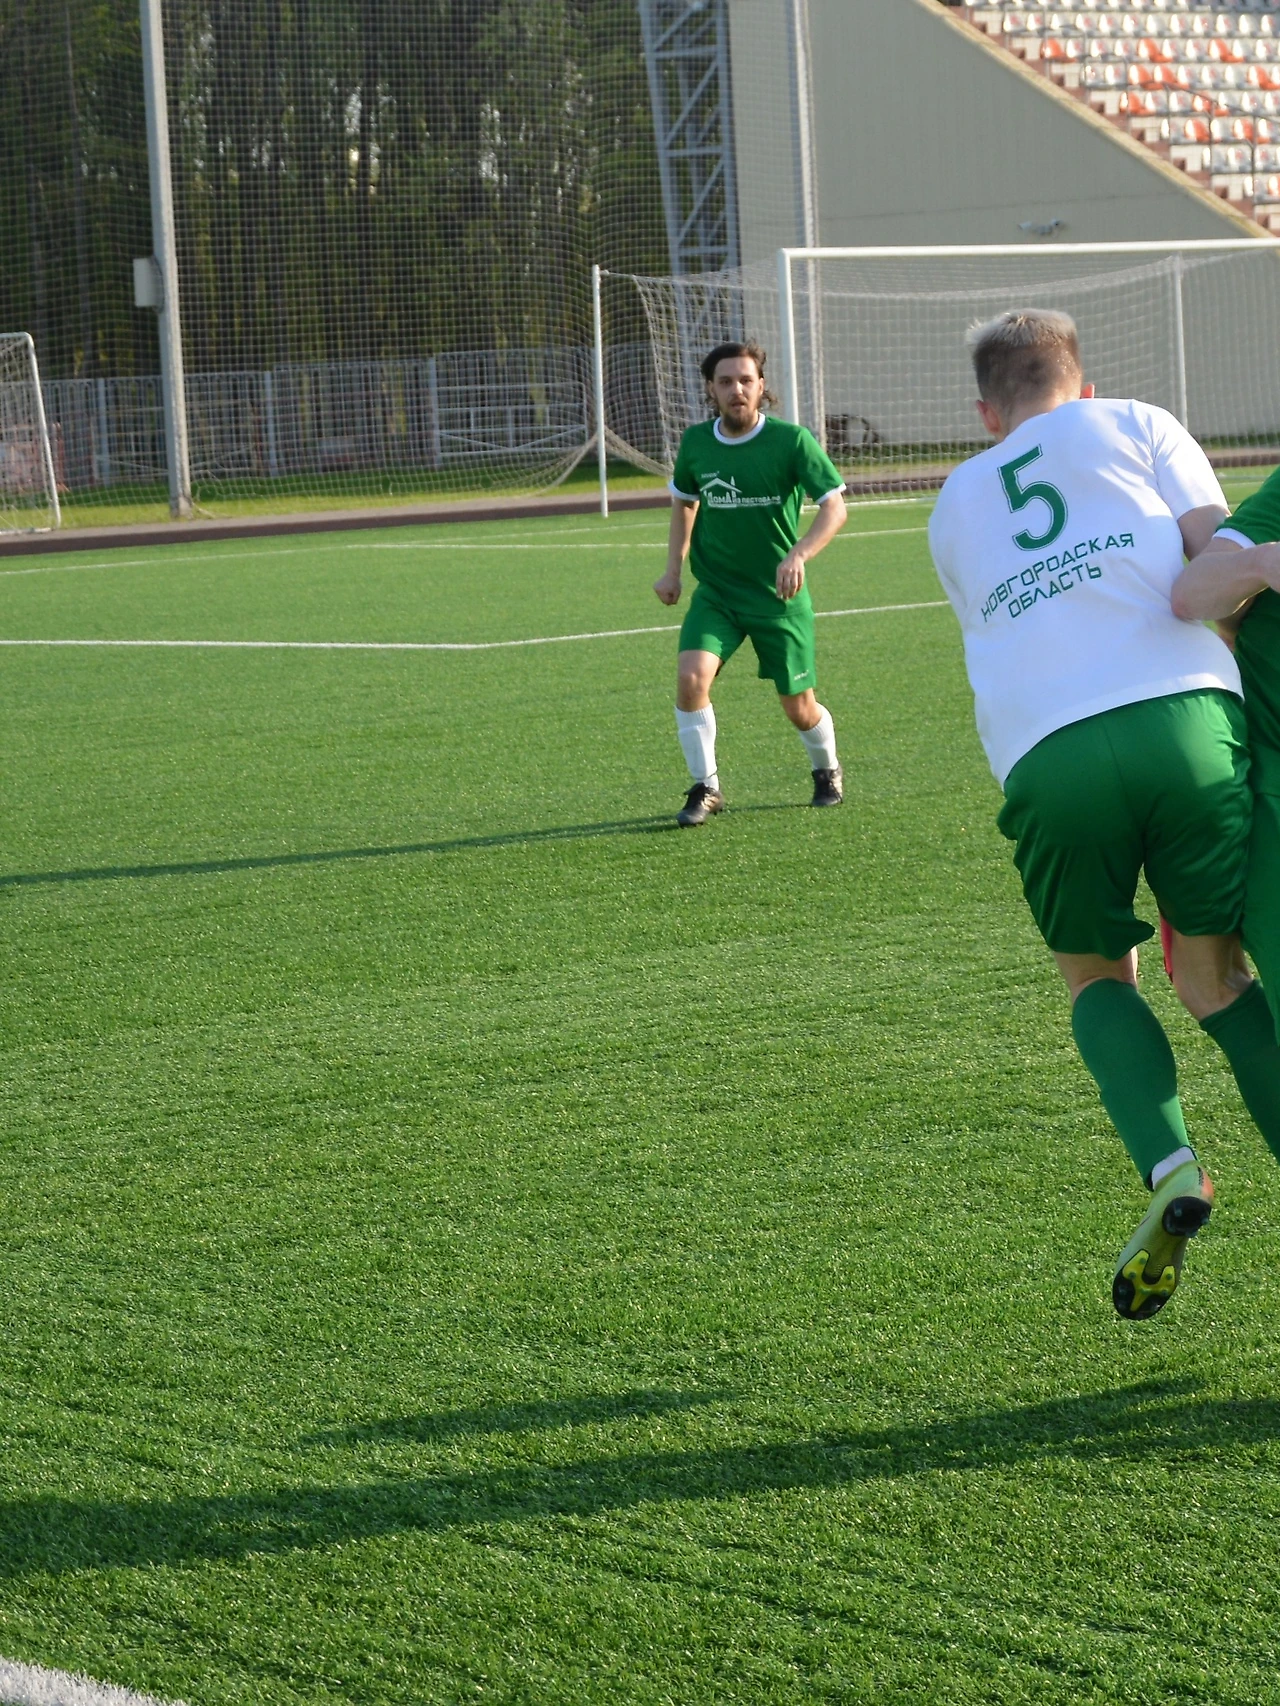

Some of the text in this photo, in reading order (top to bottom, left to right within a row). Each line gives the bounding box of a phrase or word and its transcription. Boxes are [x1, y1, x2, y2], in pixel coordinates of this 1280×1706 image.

[998, 444, 1068, 551] 5
[980, 532, 1135, 623] НОВГОРОДСКАЯ
[1008, 562, 1102, 618] ОБЛАСТЬ
